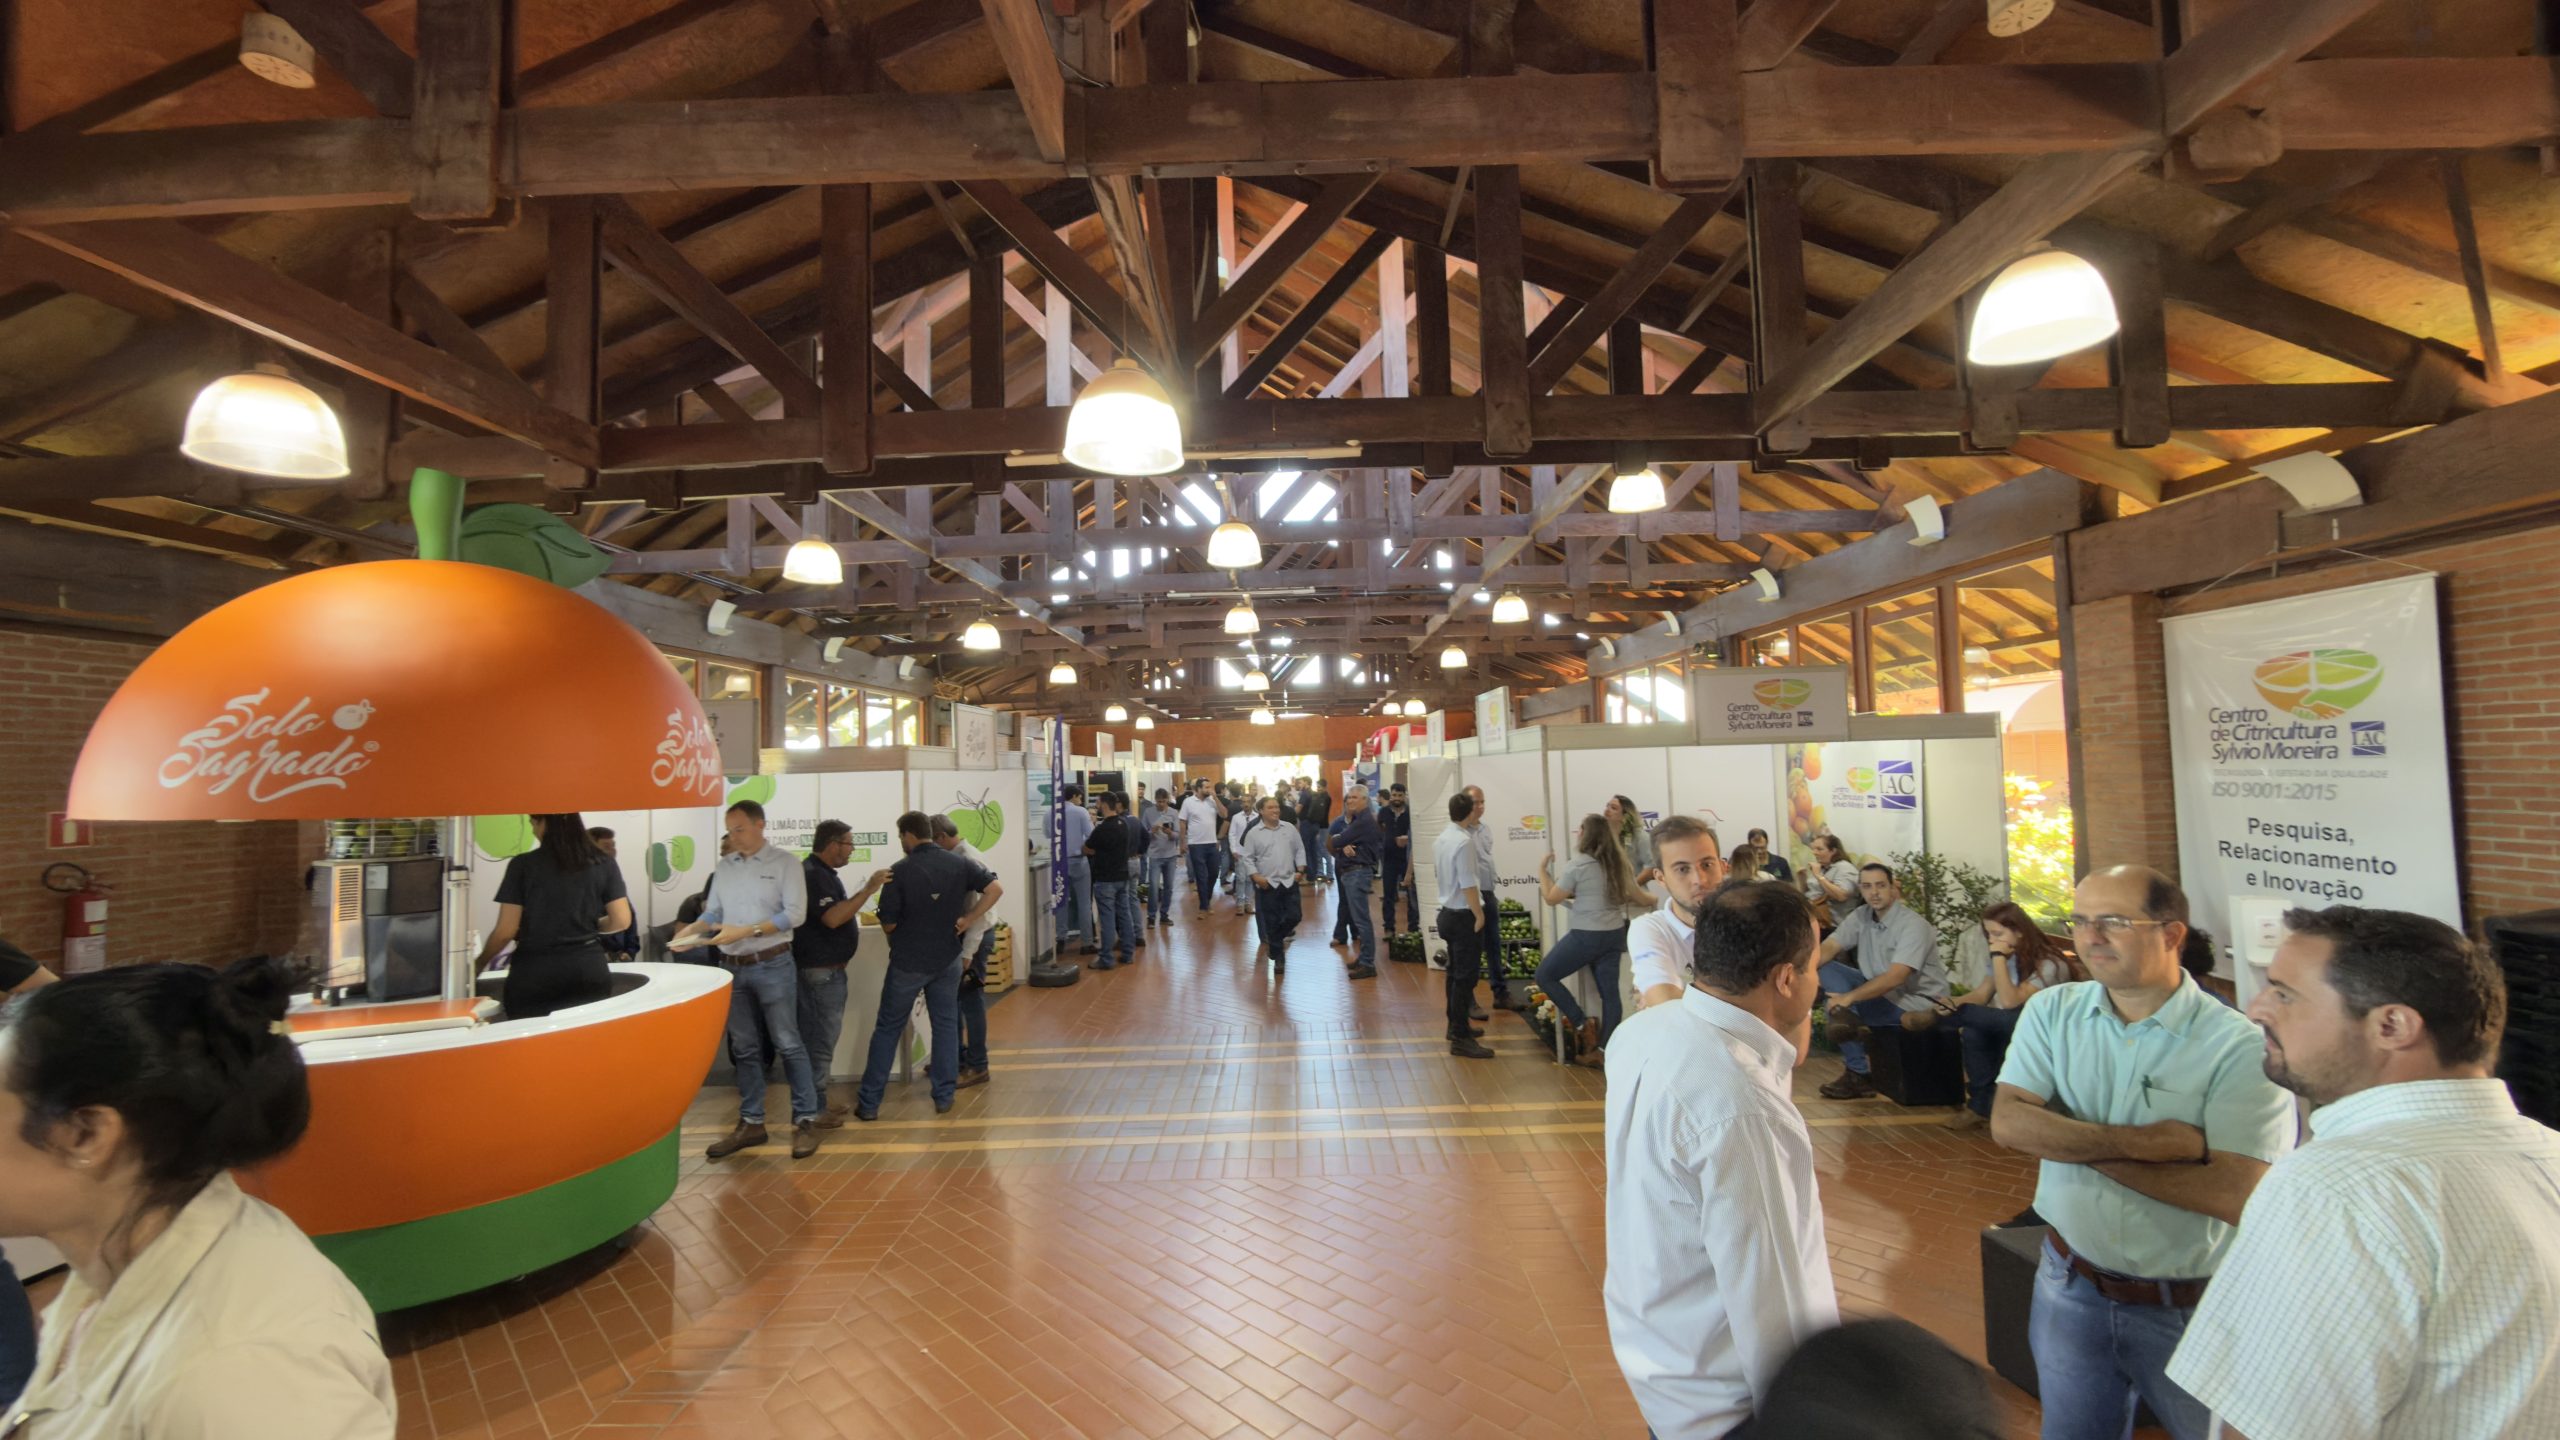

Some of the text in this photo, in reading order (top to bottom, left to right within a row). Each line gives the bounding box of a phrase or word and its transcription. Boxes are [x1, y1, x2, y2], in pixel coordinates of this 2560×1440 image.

[200, 687, 326, 748] Solo
[1727, 703, 1759, 712] Centro
[1740, 711, 1792, 721] Citricultura
[2209, 707, 2268, 724] Centro
[1755, 721, 1792, 729] Moreira
[2210, 721, 2338, 742] de Citricultura
[2351, 730, 2387, 747] IAC
[2211, 740, 2339, 764] Sylvio Moreira
[158, 727, 372, 803] Sagrado
[1879, 774, 1916, 795] IAC
[2212, 781, 2338, 801] ISO 9001:2015
[2247, 817, 2355, 846] Pesquisa,
[2218, 840, 2397, 876] Relacionamento
[2246, 870, 2364, 901] e Inovação
